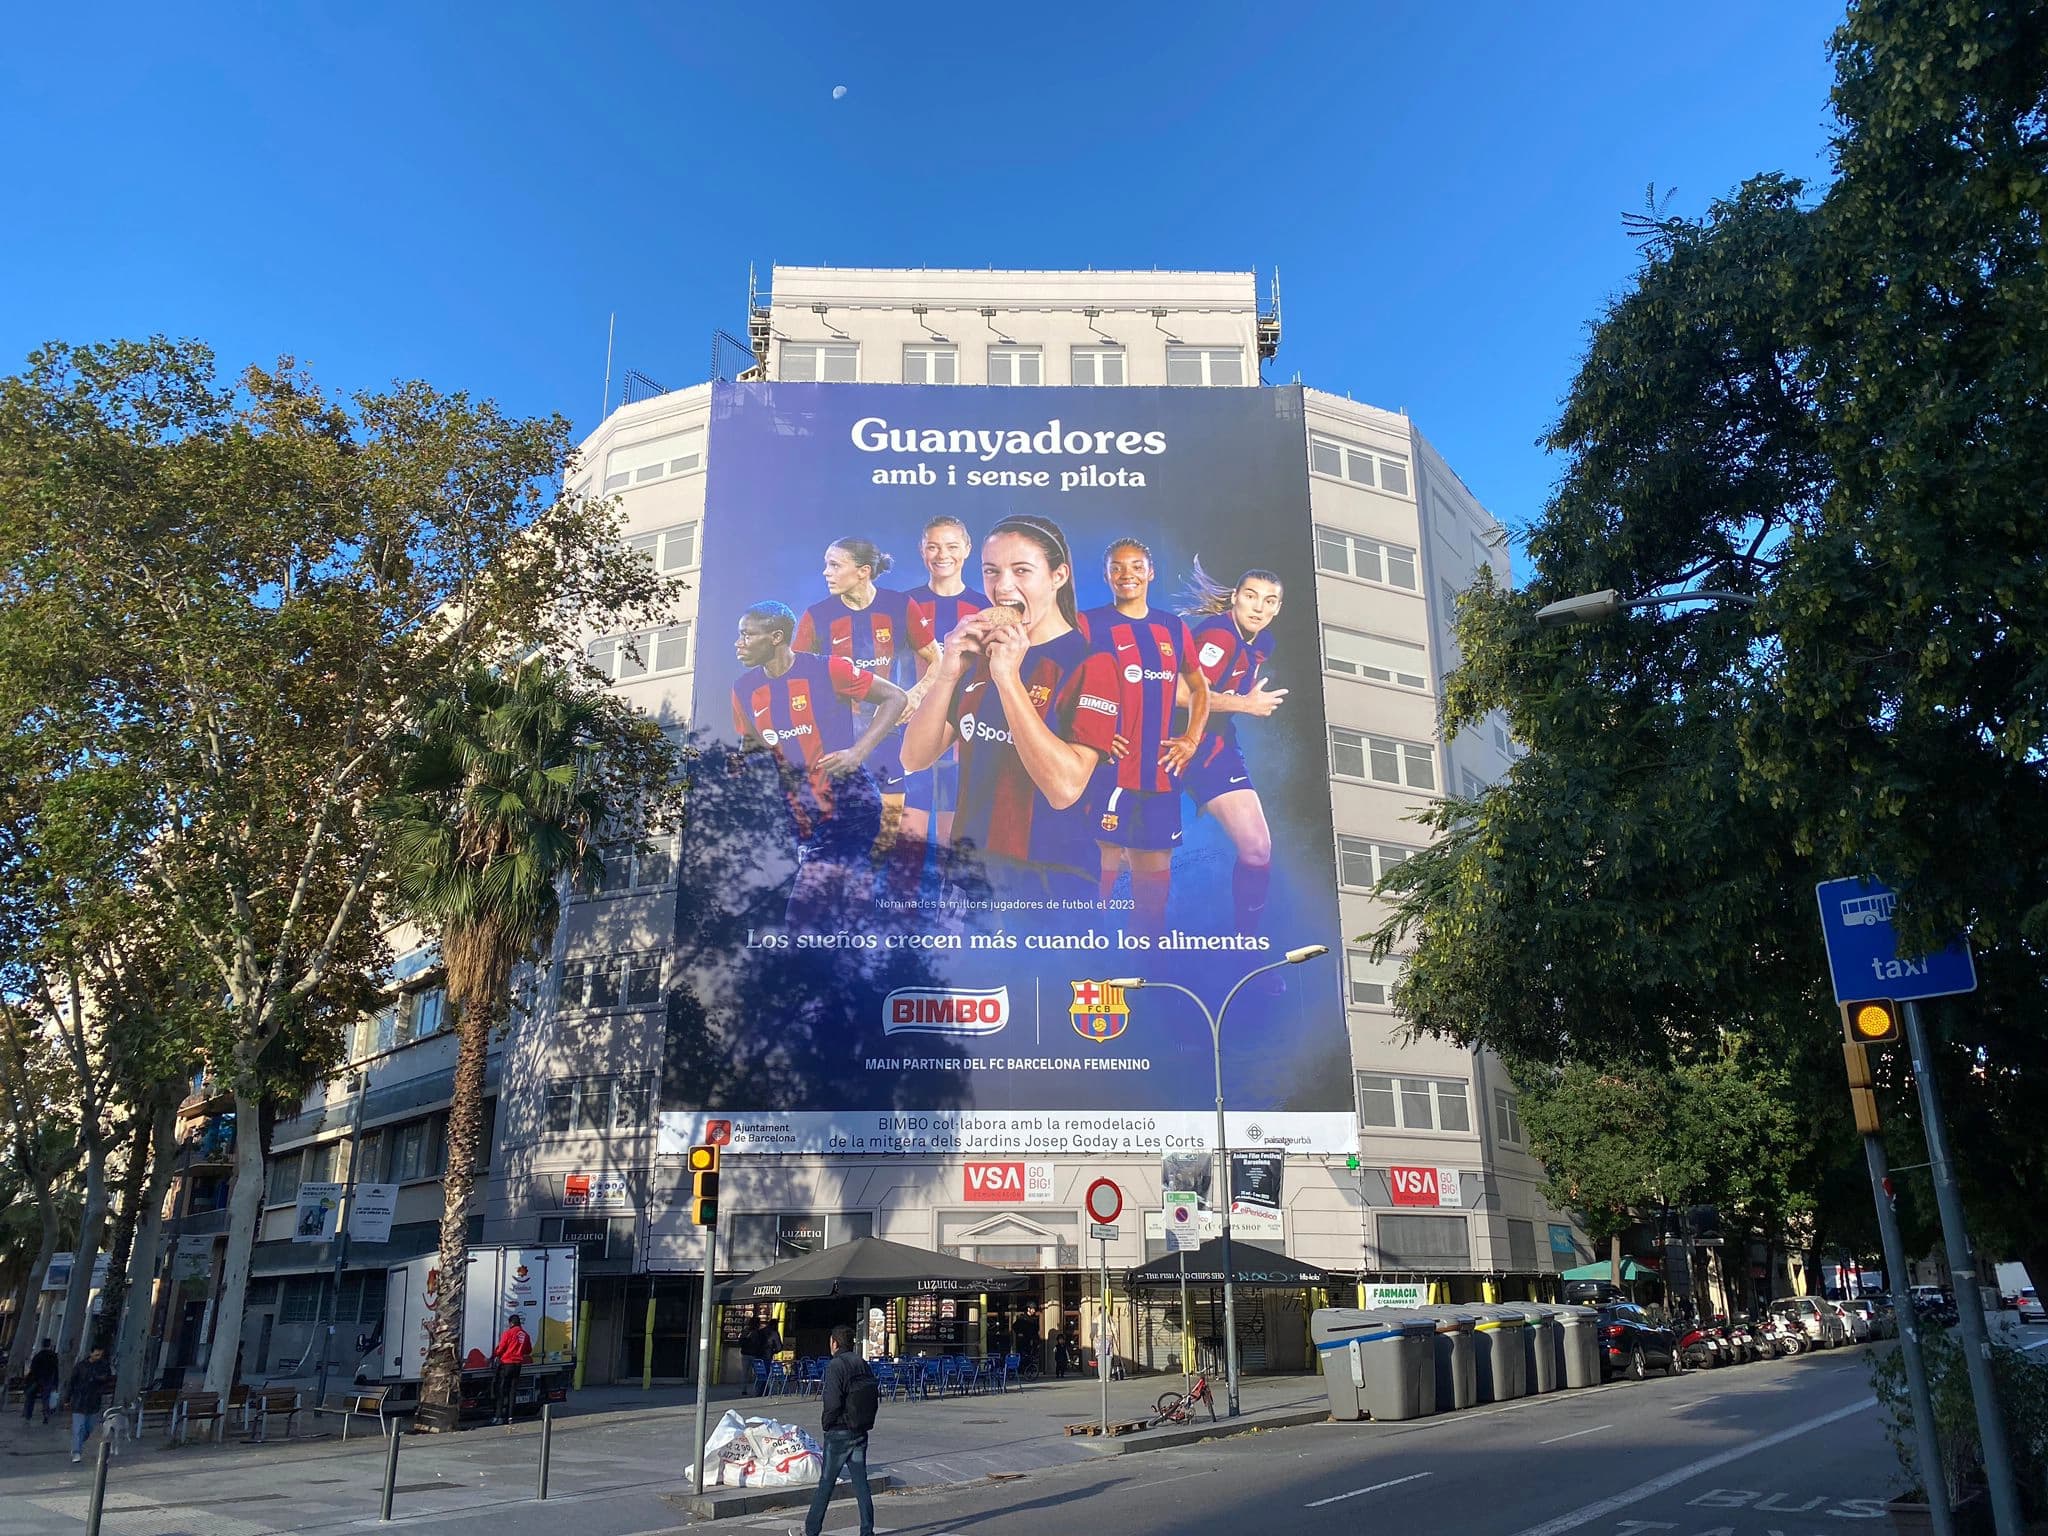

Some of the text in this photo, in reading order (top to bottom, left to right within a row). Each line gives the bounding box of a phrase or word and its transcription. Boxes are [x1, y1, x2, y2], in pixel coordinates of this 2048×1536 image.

[851, 417, 1167, 461] Guanyadores
[871, 463, 1147, 491] amb i sense pilota
[855, 655, 892, 670] Spotify
[1143, 669, 1175, 682] Spotify
[1078, 696, 1117, 714] BIMBO
[778, 724, 813, 740] Spotify
[976, 721, 1014, 745] Spot
[875, 899, 1136, 912] Nominades a millors jugadores de futbol el 2023
[746, 928, 1270, 950] Los sueños crecen más cuando los alimentas
[1871, 956, 1929, 981] taxi
[892, 998, 1001, 1023] BIMBO
[865, 1058, 1150, 1070] MAIN PARTNER DEL FC BARCELONA FEMENINO
[734, 1123, 789, 1134] Ajuntament
[879, 1117, 1156, 1130] BIMBO col·labora amb la remodelació
[734, 1133, 796, 1142] de Barcelona
[829, 1134, 1205, 1151] de la mitgera dels Jardins Josep Goday a Les Corts
[967, 1166, 1021, 1190] VSA
[1028, 1166, 1044, 1178] GO
[1440, 1172, 1452, 1183] GO
[1029, 1178, 1051, 1189] BIG!
[1393, 1170, 1436, 1194] VSA
[1441, 1183, 1458, 1195] BIG!
[1190, 1272, 1211, 1280] CHIPS
[1211, 1272, 1226, 1280] SHO
[1373, 1288, 1418, 1298] FARMACIA
[1685, 1488, 1888, 1519] BUS
